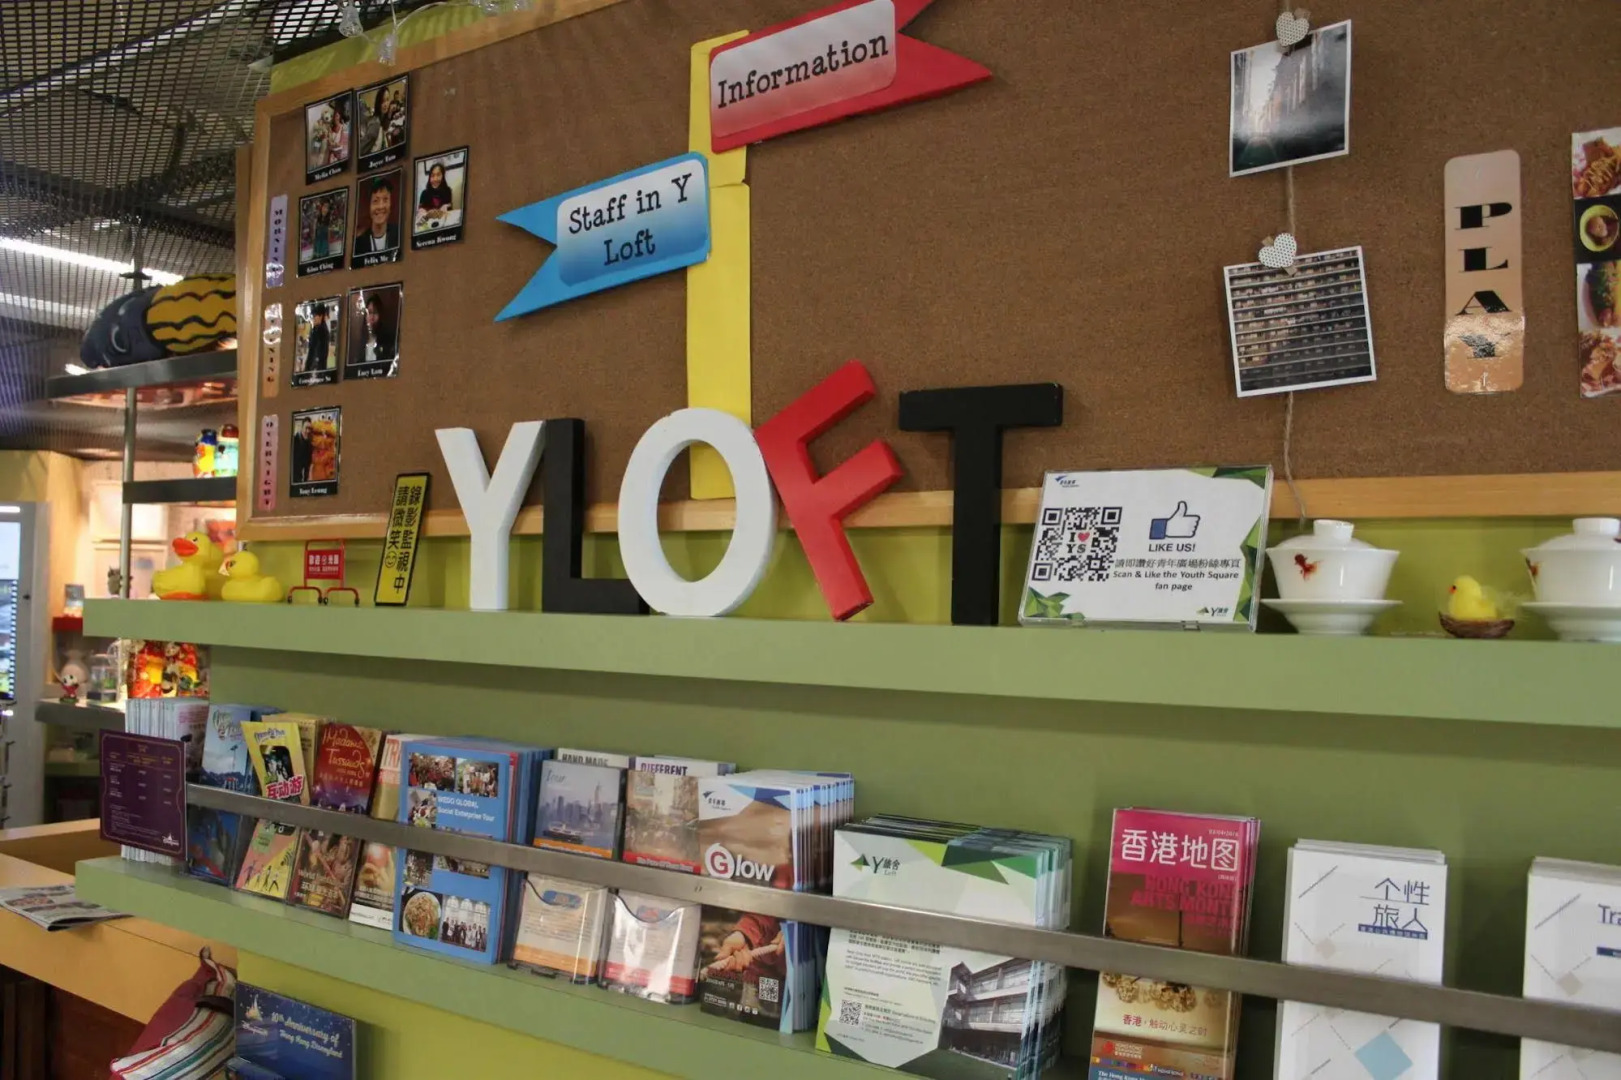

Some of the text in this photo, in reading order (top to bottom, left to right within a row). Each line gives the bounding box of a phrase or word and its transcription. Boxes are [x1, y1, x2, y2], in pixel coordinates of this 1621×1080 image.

[717, 34, 889, 109] Information
[568, 173, 692, 234] Staff in Y
[603, 228, 656, 265] Loft
[1454, 201, 1514, 360] PLAY
[264, 421, 274, 506] OVERNIGHT
[1148, 543, 1196, 552] LIKE US!
[1113, 570, 1239, 580] Scan & Like the Youth Square
[1155, 582, 1193, 592] fan page
[641, 762, 688, 777] DIFFERENT
[1121, 828, 1240, 872] 香港地图
[710, 851, 775, 882] Glow
[1374, 877, 1430, 906] 个性
[1373, 903, 1428, 932] 旅人
